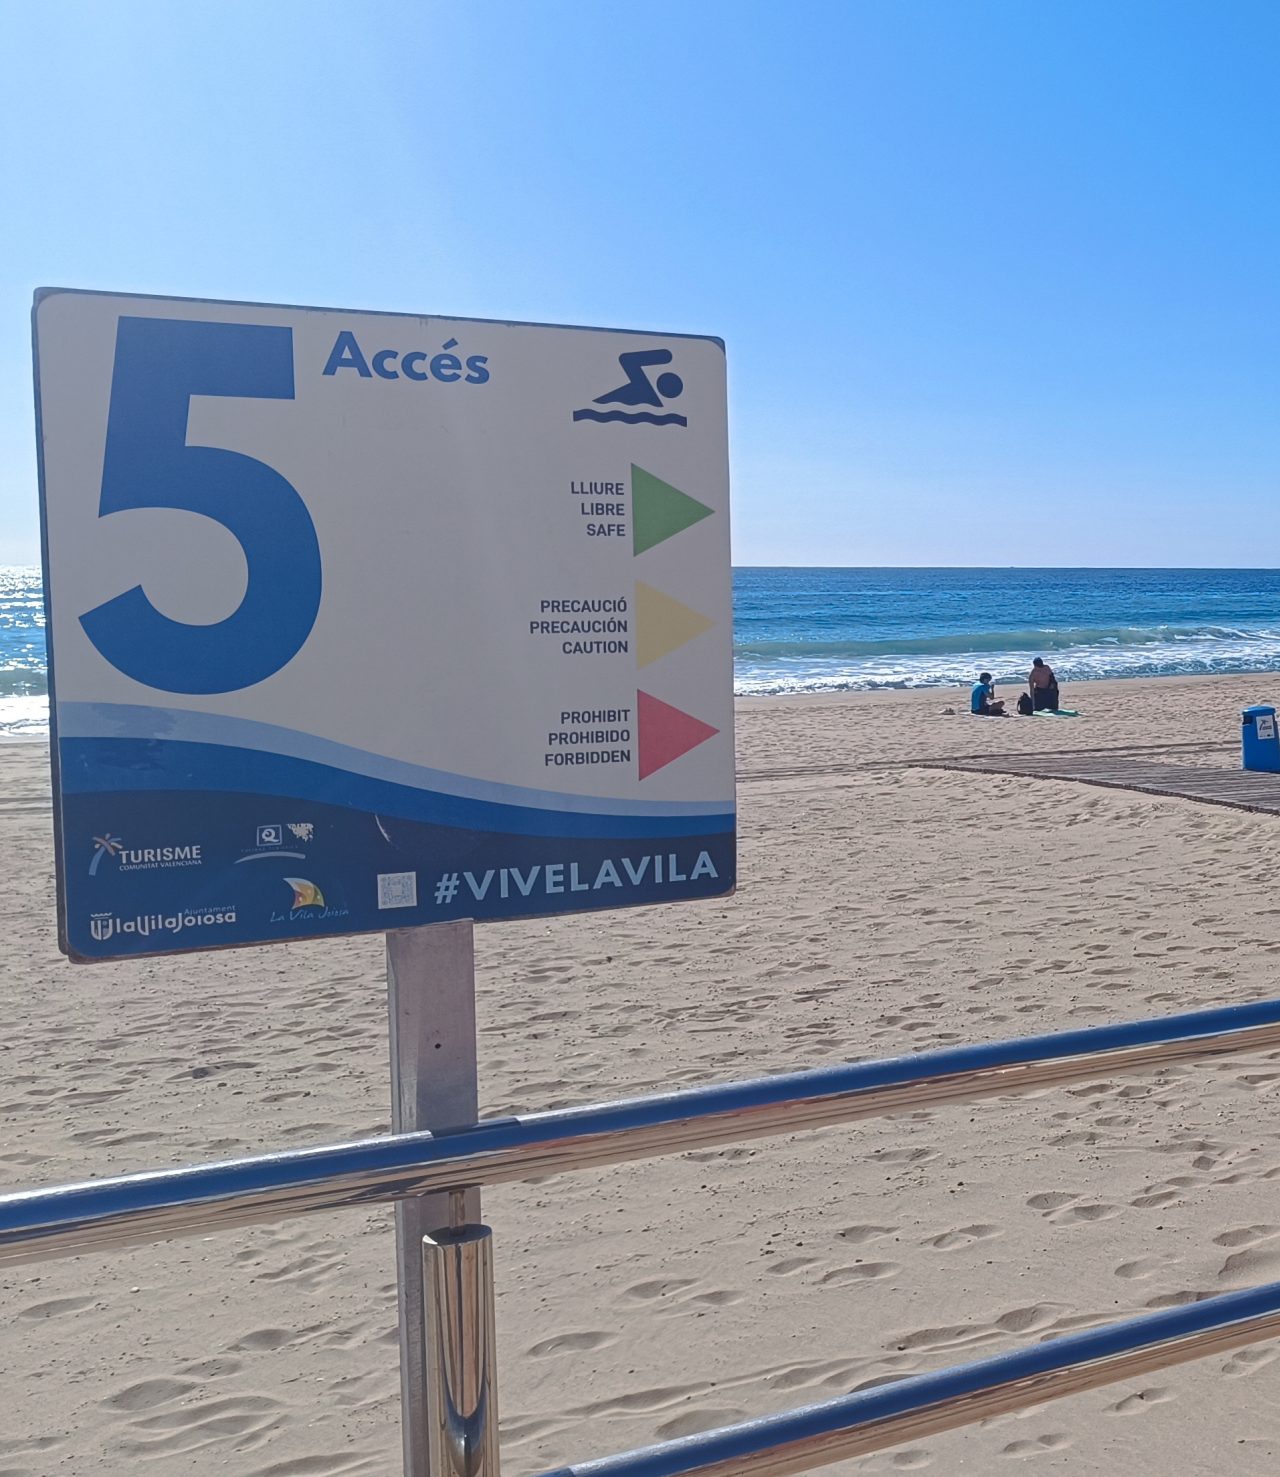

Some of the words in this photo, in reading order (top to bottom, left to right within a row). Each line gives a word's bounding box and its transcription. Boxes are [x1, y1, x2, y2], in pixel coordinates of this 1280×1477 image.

[322, 331, 490, 384] Accés
[571, 481, 625, 496] LLIURE
[78, 316, 322, 695] 5
[581, 502, 625, 516] LIBRE
[586, 523, 626, 537] SAFE
[540, 597, 628, 613] PRECAUCIÓ
[530, 617, 628, 634] PRECAUCIÓN
[562, 641, 629, 655] CAUTION
[561, 709, 630, 724] PROHIBIT
[549, 730, 630, 745] PROHIBIDO
[545, 750, 631, 766] FORBIDDEN
[118, 845, 202, 864] TURISME
[119, 862, 158, 872] COMUNITAT
[160, 860, 202, 868] VALENCIANA
[434, 851, 719, 905] #VIVELAVILA
[184, 905, 236, 916] Ajuntament
[270, 911, 285, 922] La
[290, 909, 314, 920] Vila
